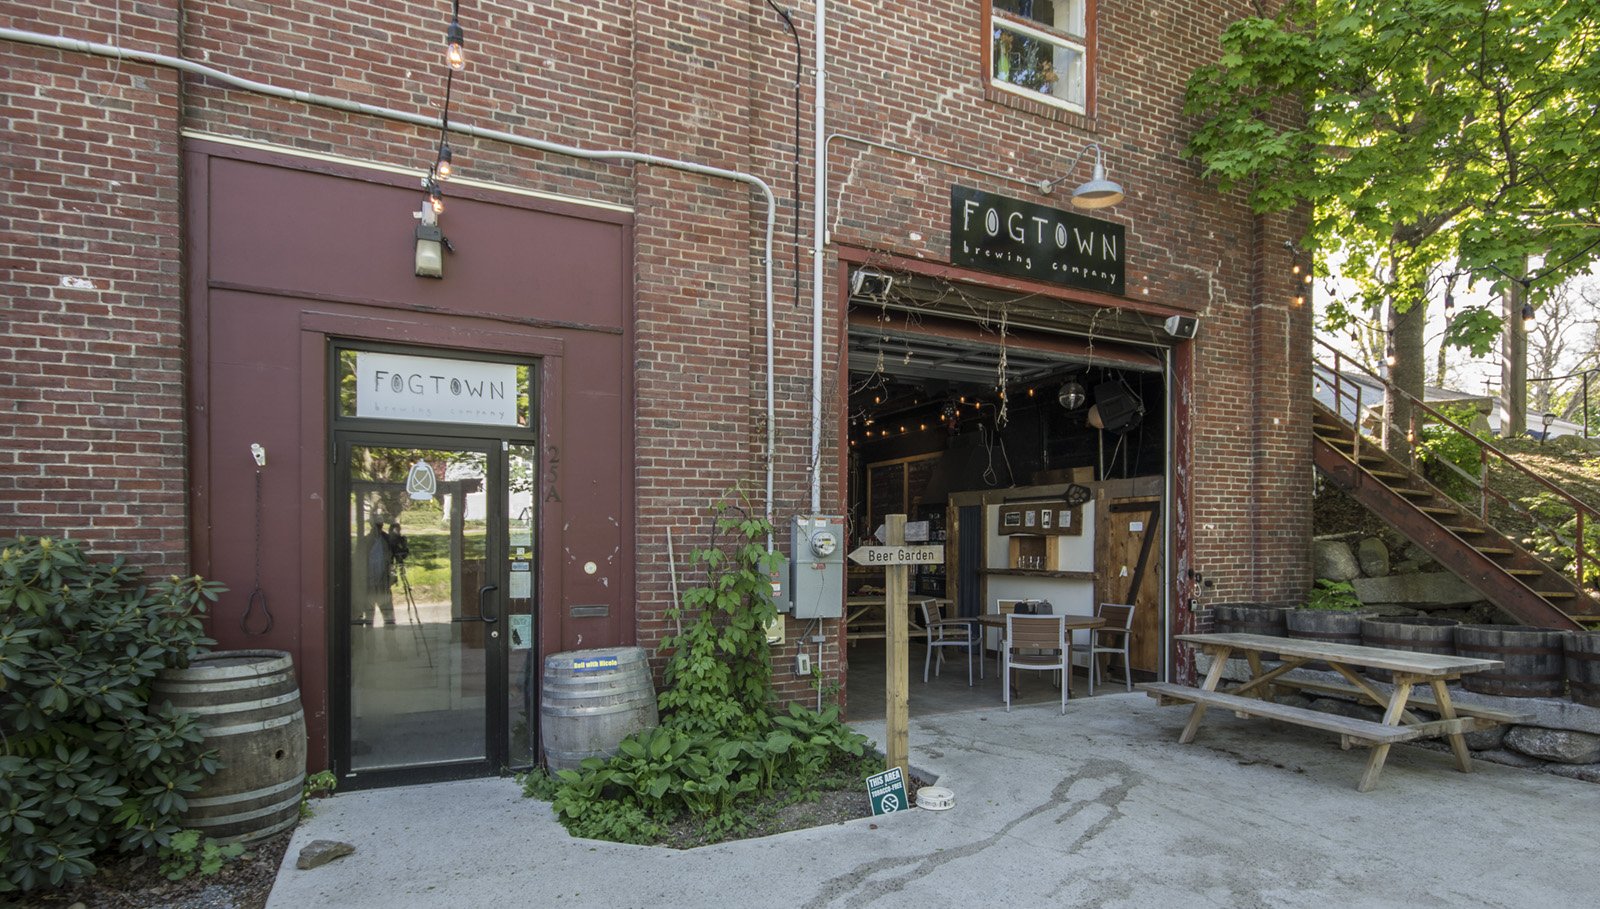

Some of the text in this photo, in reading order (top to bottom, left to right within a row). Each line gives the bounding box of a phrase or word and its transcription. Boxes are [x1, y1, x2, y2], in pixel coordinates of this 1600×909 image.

[964, 199, 1117, 262] FOGTOWN
[963, 240, 1117, 284] brewing company
[374, 370, 505, 400] FOGTOWN
[868, 549, 934, 562] Beer Garden
[869, 770, 900, 787] THIS AREA
